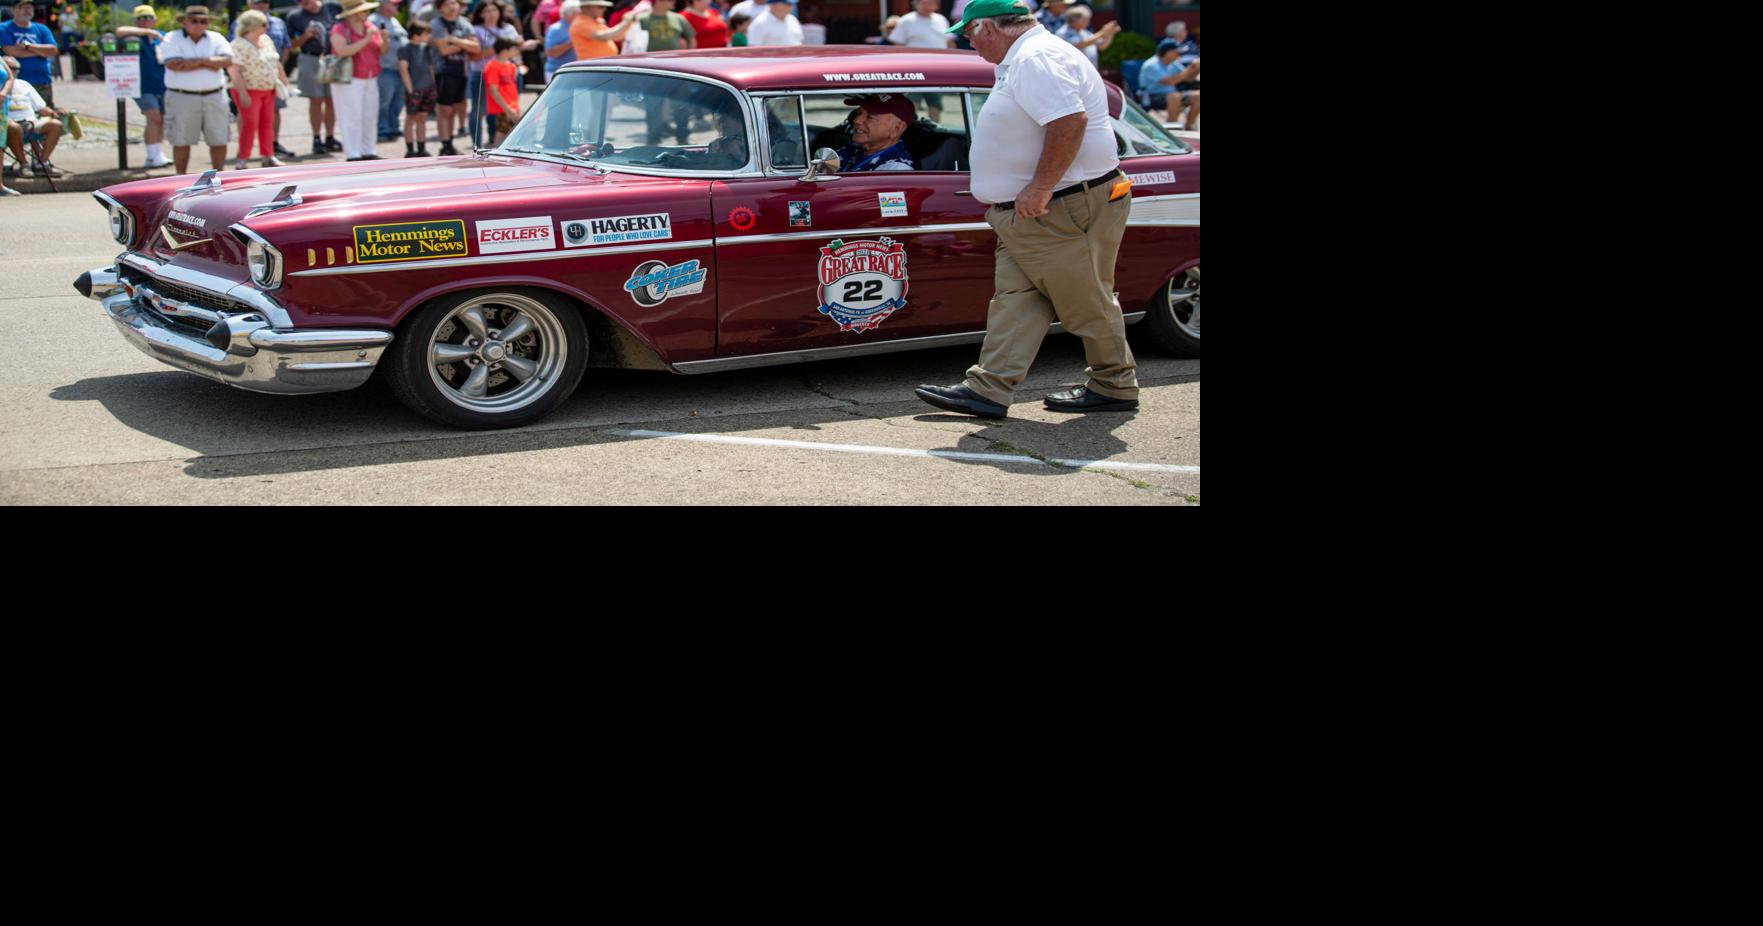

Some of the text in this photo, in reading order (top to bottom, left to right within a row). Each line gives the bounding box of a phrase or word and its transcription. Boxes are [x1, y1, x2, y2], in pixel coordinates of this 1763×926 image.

[822, 72, 926, 82] WWW.GREATRACE.COM
[591, 214, 668, 234] HAGERTY
[365, 226, 455, 243] Hemmings
[480, 227, 549, 243] ECKLER'S
[593, 229, 669, 243] FOR PEOPLE WHO LOVE CARS
[359, 243, 411, 257] Motor
[418, 239, 464, 253] News
[625, 260, 699, 290] COKER
[821, 253, 904, 285] GREAT RACE
[653, 269, 705, 294] TIRE
[843, 279, 883, 303] 22
